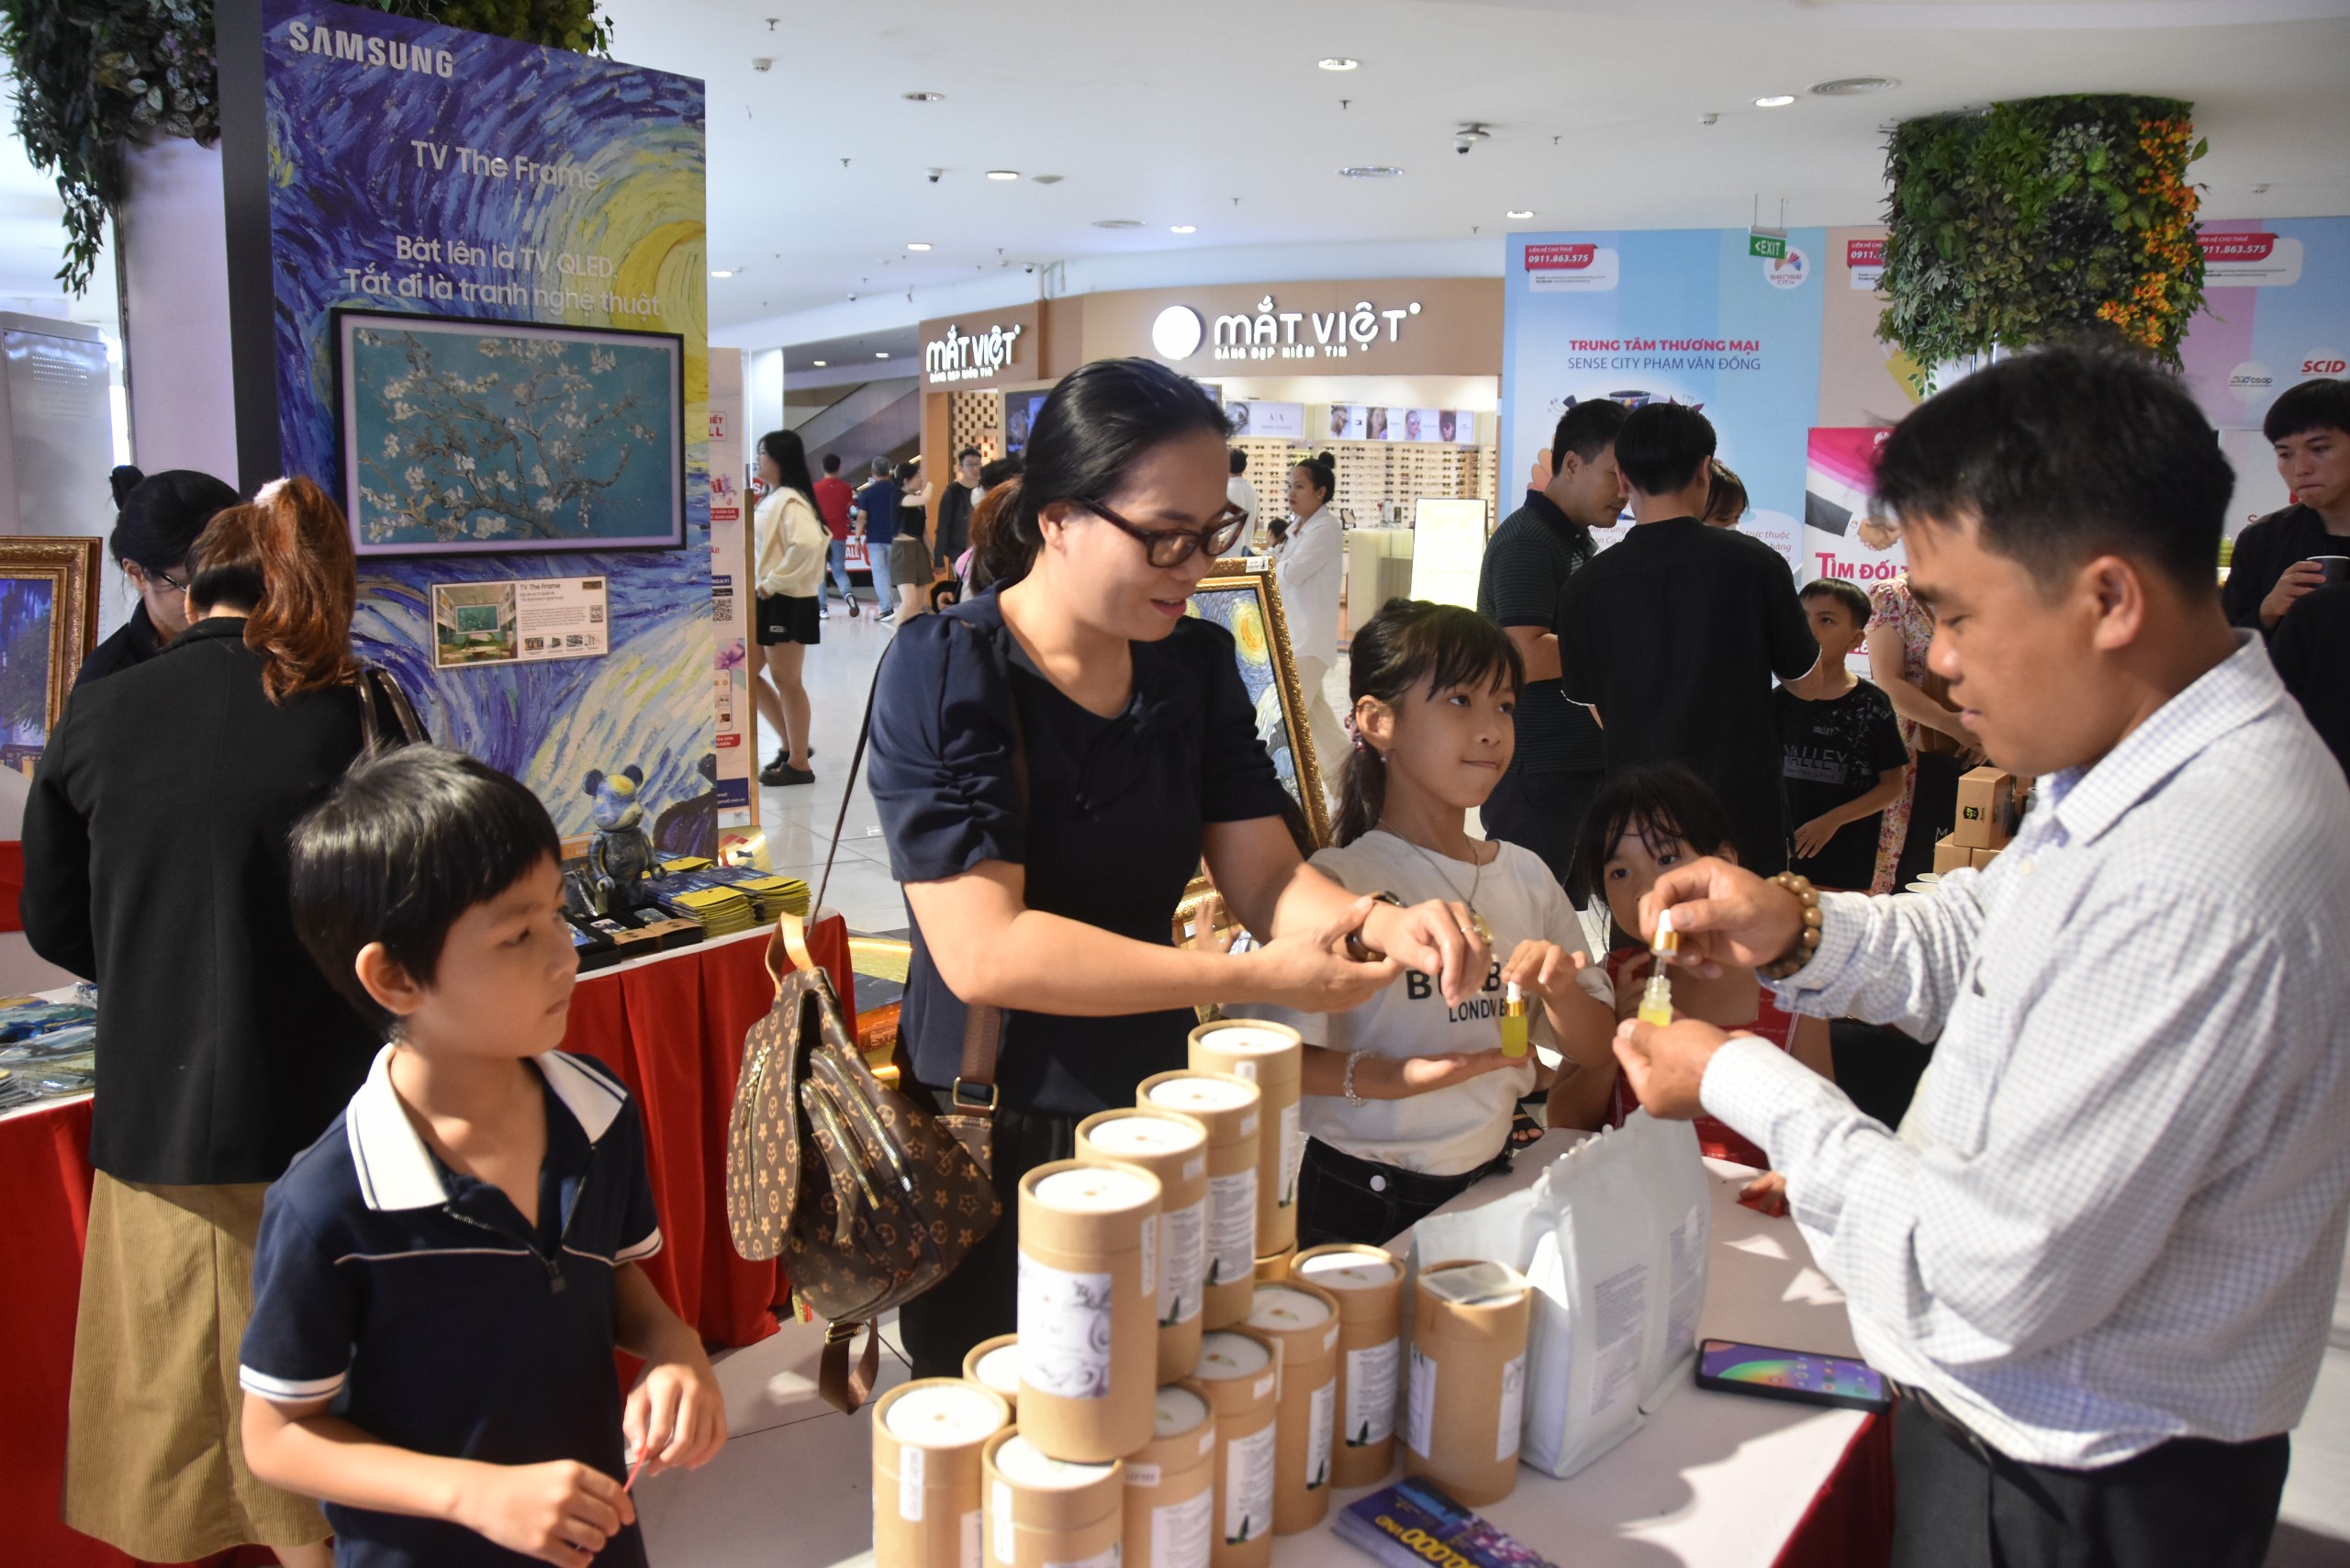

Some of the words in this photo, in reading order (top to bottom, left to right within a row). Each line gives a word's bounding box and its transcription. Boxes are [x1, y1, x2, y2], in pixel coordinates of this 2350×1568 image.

[289, 20, 453, 78] SAMSUNG
[410, 140, 448, 171] TV
[455, 146, 509, 178] The
[515, 154, 600, 191] Frame
[396, 235, 441, 269] Bật
[447, 241, 487, 267] lên
[492, 243, 514, 270] là
[520, 247, 551, 273] TV
[1761, 240, 1781, 256] EXIT
[2202, 244, 2266, 254] 911.863.575
[1528, 253, 1589, 263] 0911.863.575
[344, 264, 391, 296] Tắt
[397, 274, 423, 298] đi
[429, 275, 453, 300] là
[459, 278, 528, 306] tranh
[533, 283, 595, 317] nghệ
[599, 290, 660, 321] thuật
[1569, 340, 1620, 352] TRUNG
[1624, 337, 1656, 351] TÂM
[1660, 337, 1726, 352] THƯƠNG
[1729, 340, 1760, 355] MẠI
[1568, 357, 1607, 369] SENSE
[1611, 357, 1640, 369] CITY
[1644, 357, 1684, 372] PHẠM
[1687, 354, 1715, 369] VĂN
[2301, 360, 2346, 373] SCID
[1815, 552, 1854, 579] TÌM
[1859, 559, 1897, 580] ĐỐI
